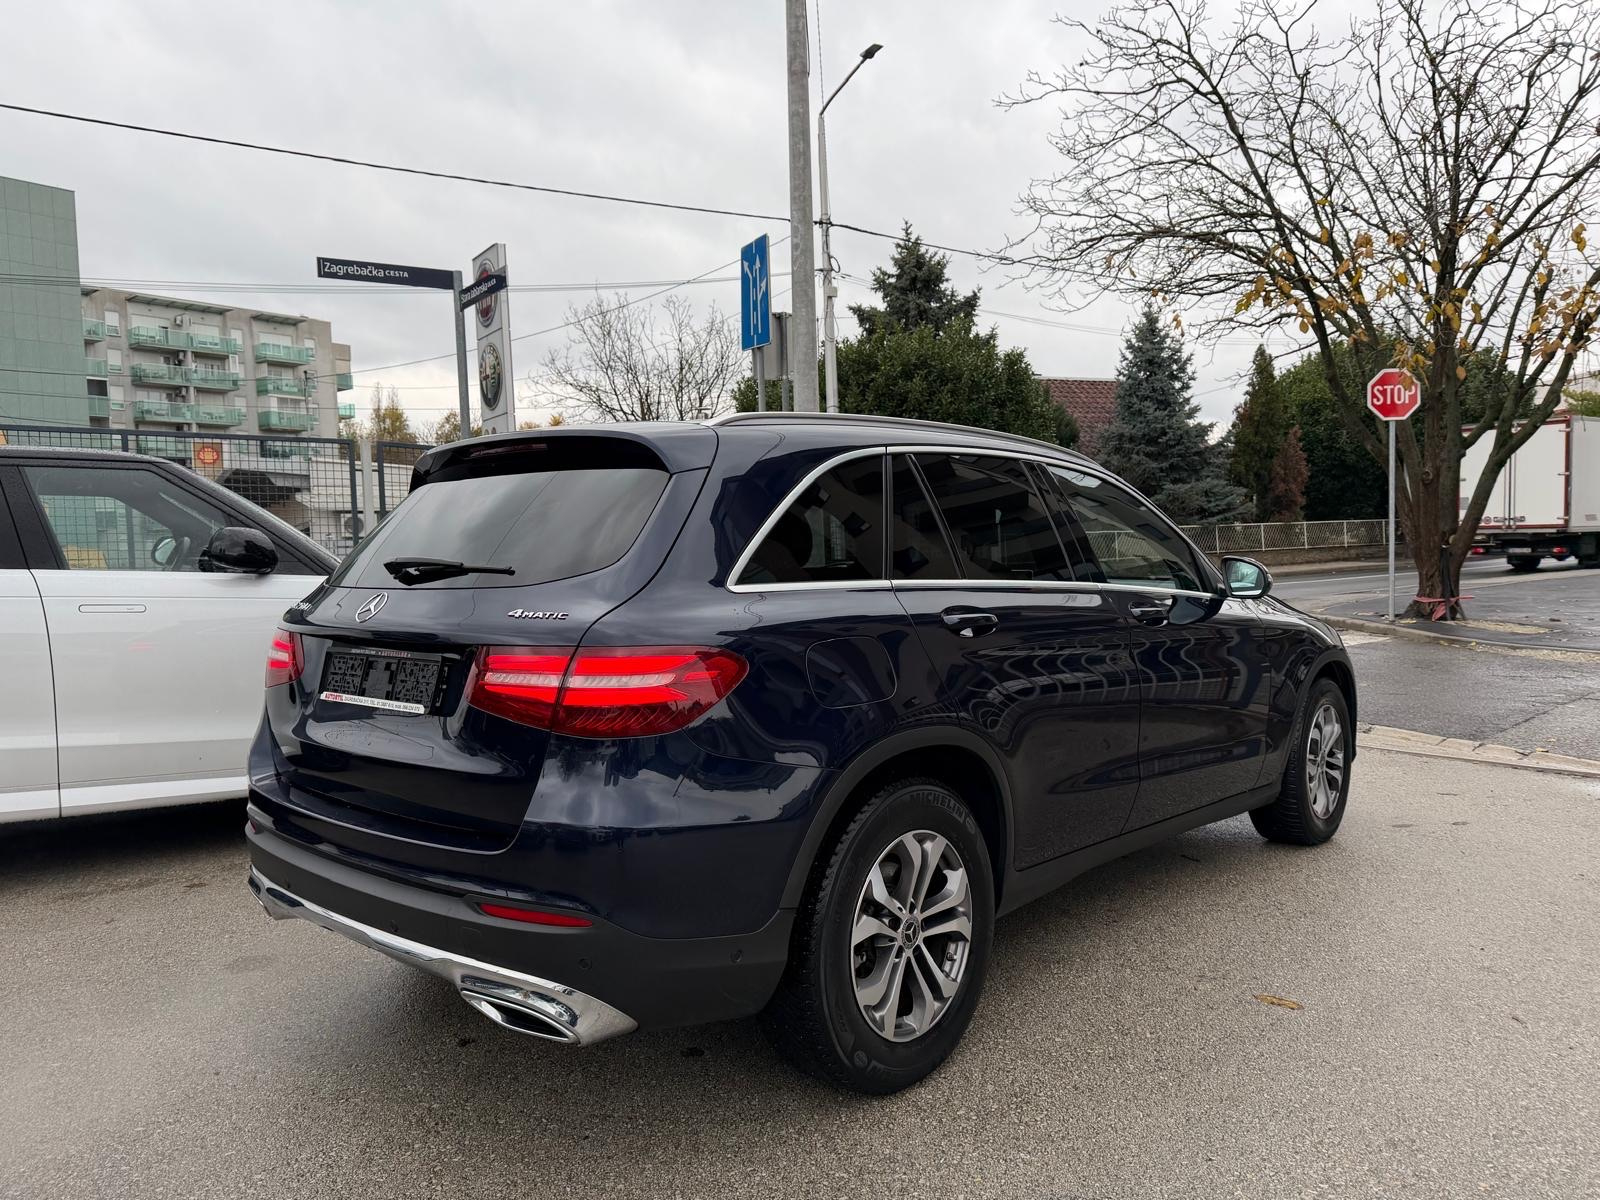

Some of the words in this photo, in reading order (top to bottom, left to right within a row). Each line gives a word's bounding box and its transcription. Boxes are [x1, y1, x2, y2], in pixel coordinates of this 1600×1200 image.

[324, 262, 384, 277] Zagrebačka
[385, 270, 409, 278] CESTA
[1373, 385, 1416, 405] STOP
[507, 608, 569, 620] 4MATIC
[907, 791, 966, 823] MICHELIN
